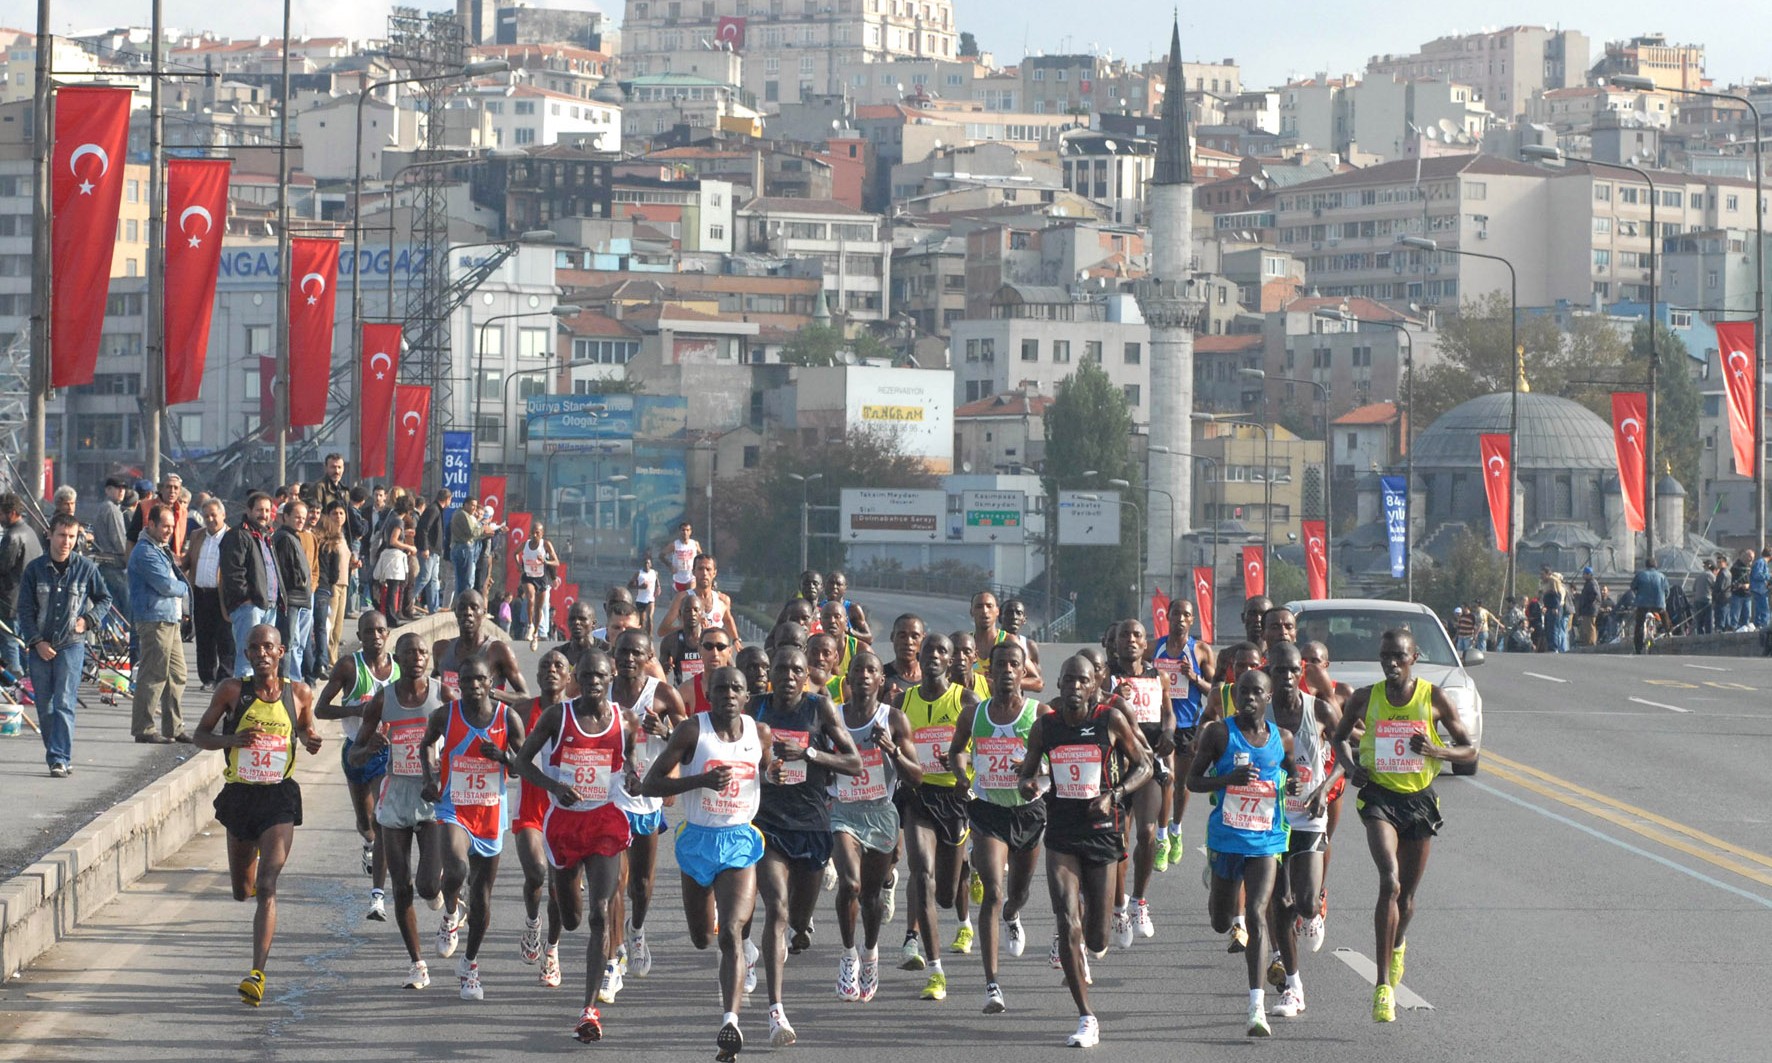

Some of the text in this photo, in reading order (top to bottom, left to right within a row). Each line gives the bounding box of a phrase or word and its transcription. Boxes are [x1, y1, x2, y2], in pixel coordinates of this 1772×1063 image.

[218, 252, 281, 277] NGAZ
[878, 387, 924, 395] REZERVASYON
[528, 401, 560, 414] Dünya
[562, 416, 598, 427] Otogaz
[445, 455, 468, 468] 84.
[444, 469, 468, 487] yılı
[1386, 495, 1405, 507] 84.
[684, 652, 703, 660] KENY
[1170, 673, 1178, 686] 9
[1133, 693, 1151, 707] 40
[1394, 739, 1405, 756] 6
[251, 751, 271, 768] 34
[406, 761, 421, 769] İSTA
[988, 755, 1008, 772] 24
[1377, 757, 1424, 766] 29. İSTANBUL
[575, 766, 596, 784] 63
[989, 774, 1018, 782] İSTANBU
[1069, 765, 1080, 781] 9
[466, 774, 486, 791] 15
[1240, 797, 1261, 813] 77
